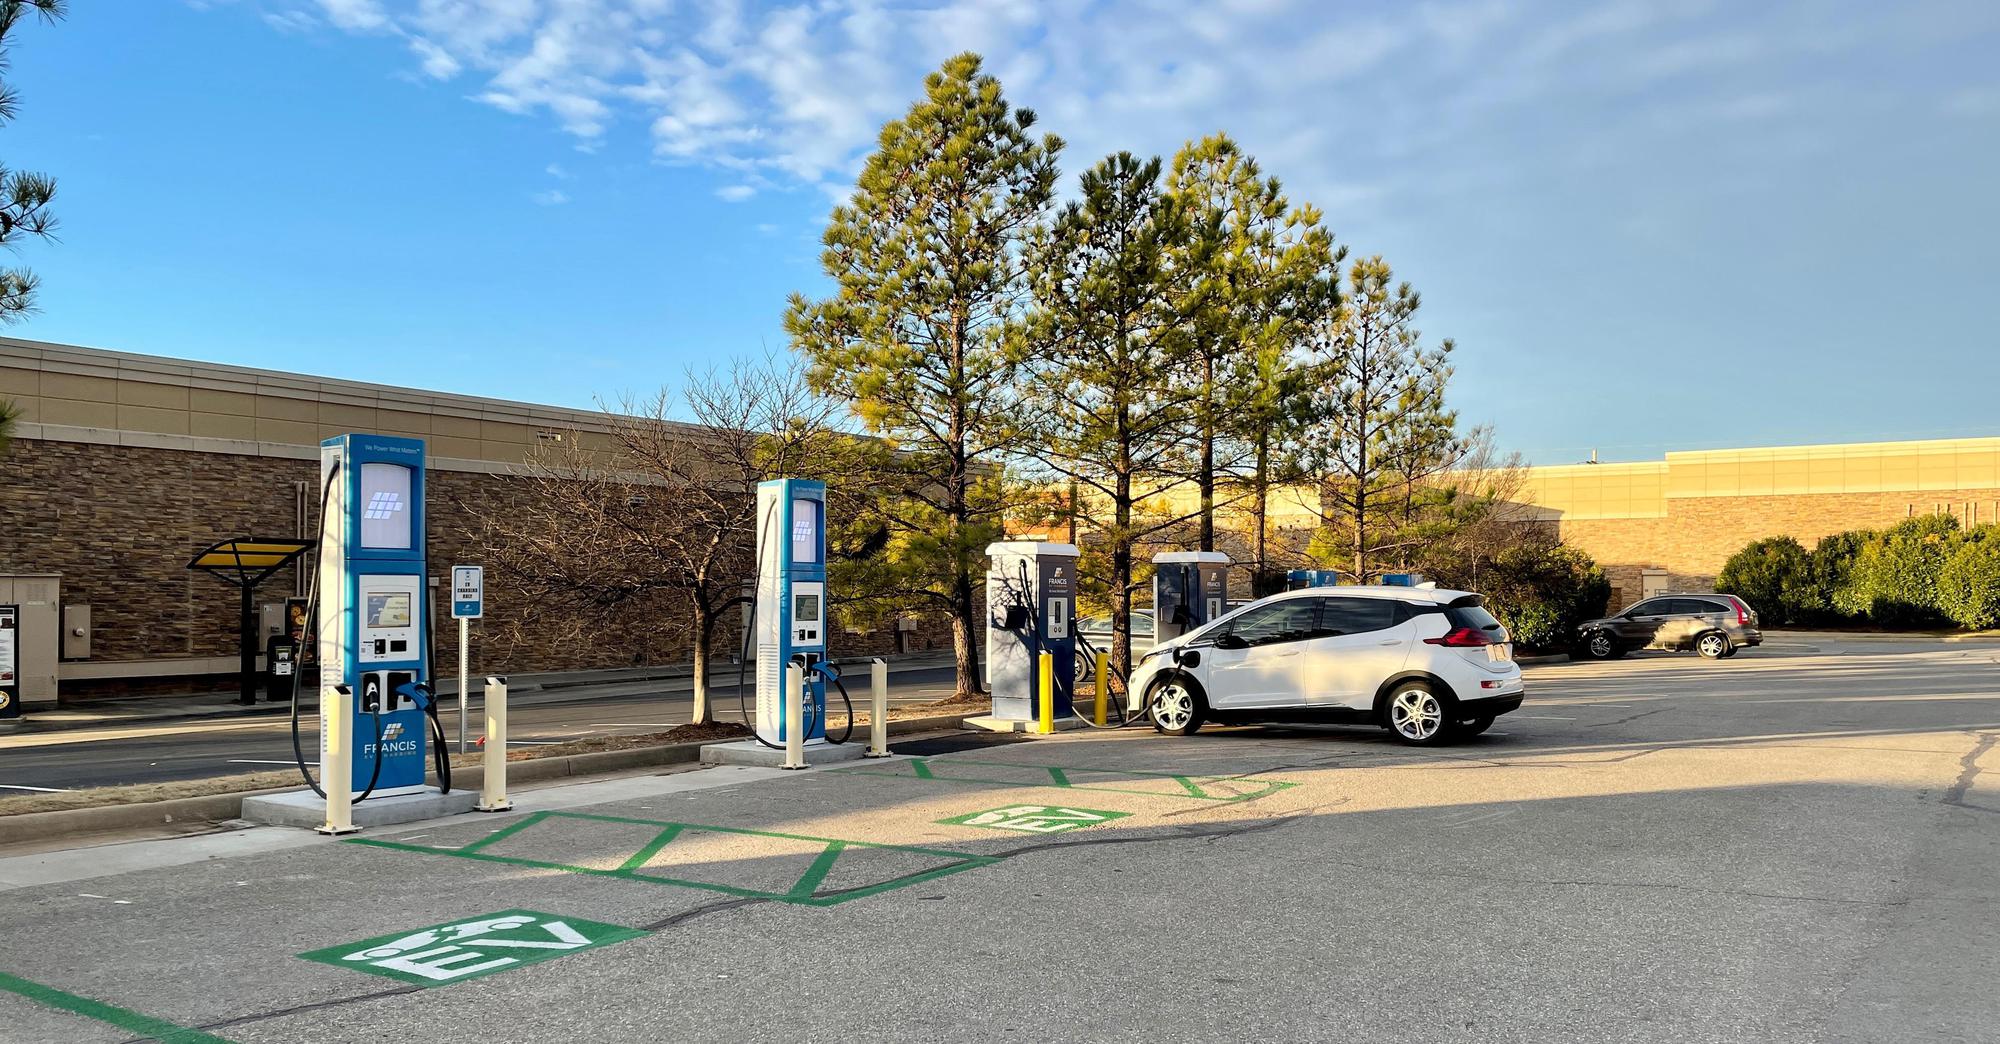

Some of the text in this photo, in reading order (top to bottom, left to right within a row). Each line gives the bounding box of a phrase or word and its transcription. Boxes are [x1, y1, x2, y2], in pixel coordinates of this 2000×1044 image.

[803, 704, 822, 712] ANIS
[988, 808, 1106, 832] EV
[369, 921, 593, 980] EV
